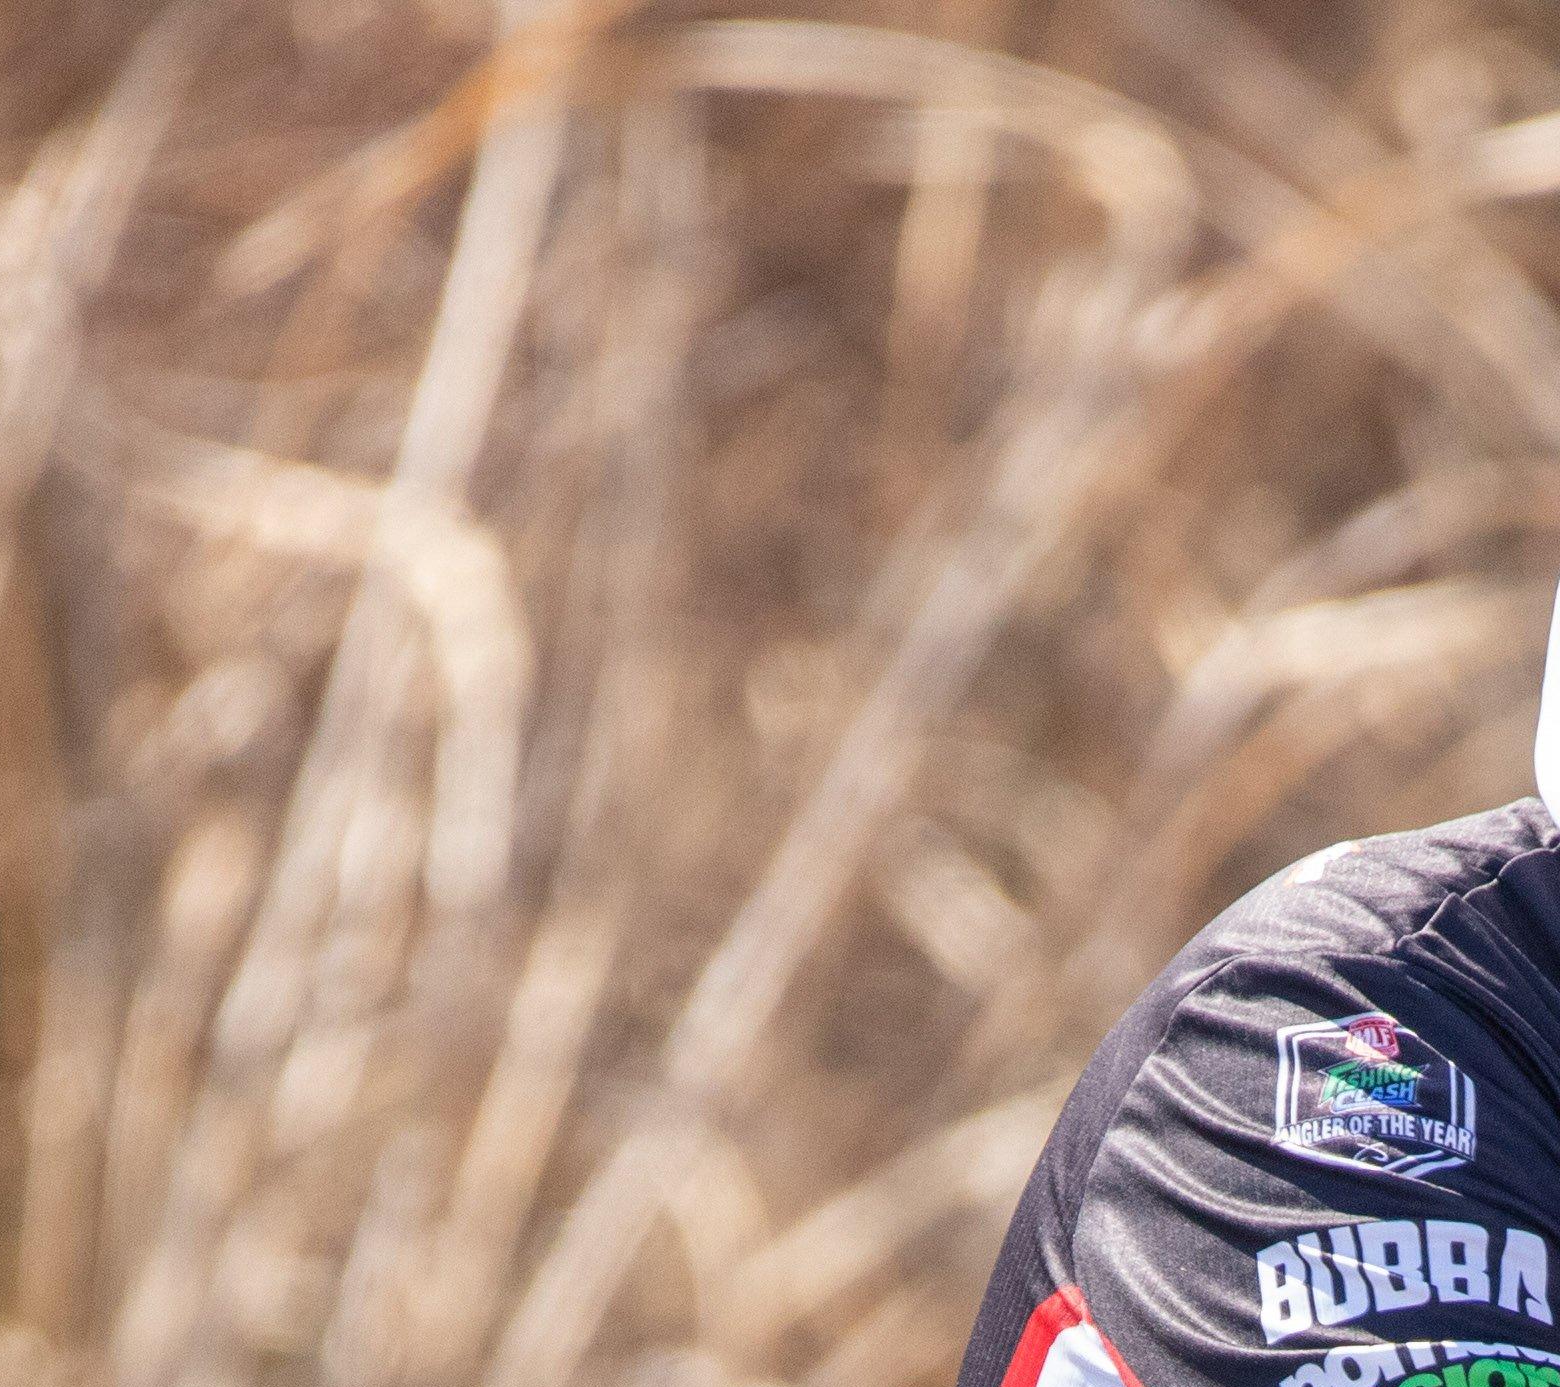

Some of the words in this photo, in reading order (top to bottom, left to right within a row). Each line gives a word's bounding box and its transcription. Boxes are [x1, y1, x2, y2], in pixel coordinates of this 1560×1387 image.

[1348, 1114, 1376, 1136] OF
[1377, 1115, 1416, 1142] THE
[1420, 1118, 1475, 1156] YEAR
[1257, 1219, 1554, 1346] BUBBA
